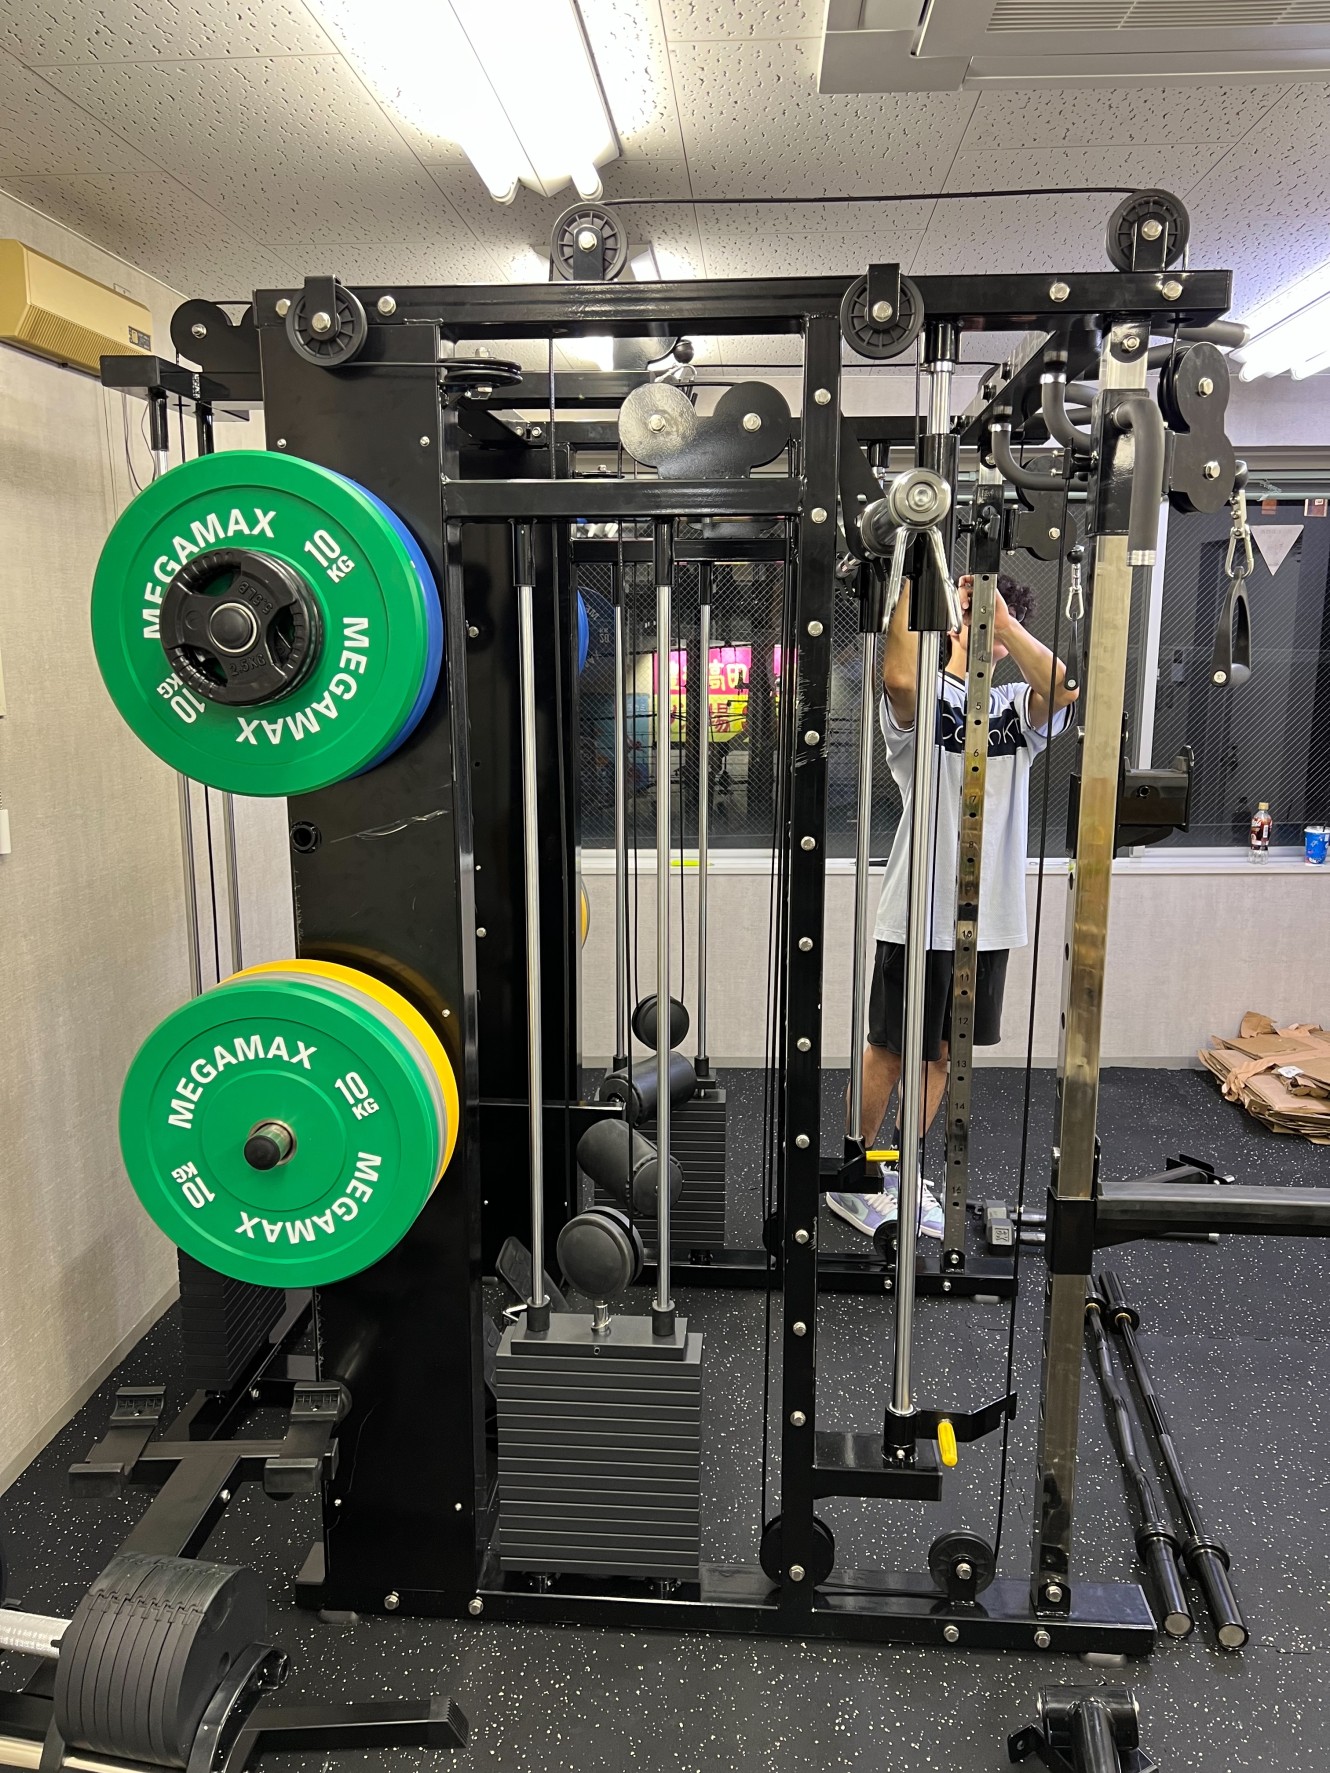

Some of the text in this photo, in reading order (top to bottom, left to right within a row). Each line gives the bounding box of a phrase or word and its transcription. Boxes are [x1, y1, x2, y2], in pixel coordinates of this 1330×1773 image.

[304, 529, 341, 567] 10
[326, 555, 355, 583] KG
[980, 605, 987, 614] 3
[229, 653, 267, 677] 2.5KG
[978, 654, 985, 662] 4
[156, 672, 184, 699] KG
[235, 617, 370, 745] MEGAMAX
[170, 687, 206, 724] 10
[976, 702, 982, 710] 5
[973, 748, 979, 757] 6
[971, 795, 977, 803] 7
[968, 840, 974, 848] 8
[962, 930, 973, 939] 10
[960, 974, 970, 982] 11
[959, 1017, 969, 1025] 12
[957, 1060, 967, 1068] 13
[167, 1034, 318, 1130] MEGAMAX
[334, 1071, 369, 1105] 10
[351, 1098, 380, 1121] KG
[955, 1102, 965, 1110] 14
[171, 1161, 199, 1183] KG
[181, 1176, 216, 1209] 10
[952, 1185, 962, 1194] 16
[234, 1151, 382, 1245] MEGAMAX
